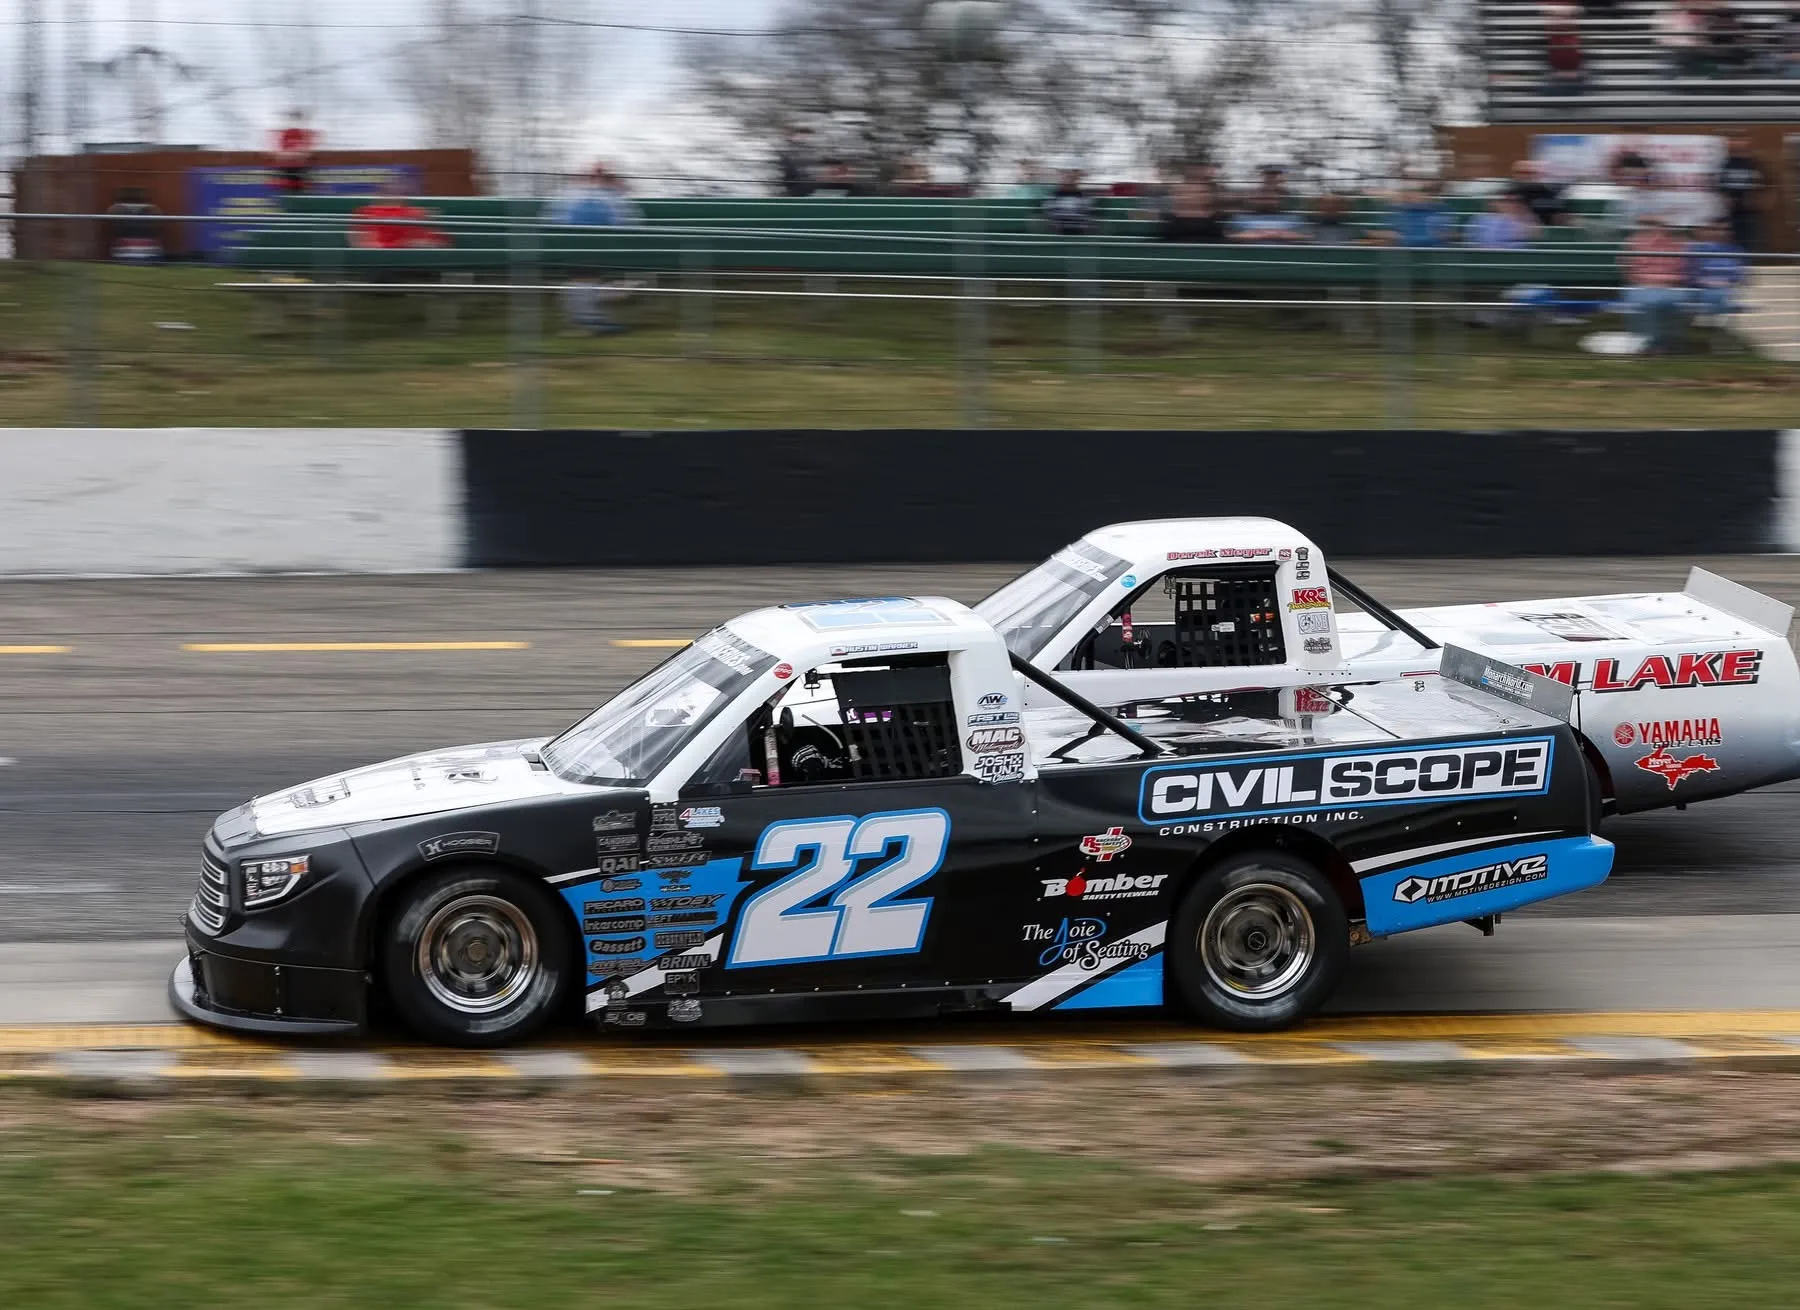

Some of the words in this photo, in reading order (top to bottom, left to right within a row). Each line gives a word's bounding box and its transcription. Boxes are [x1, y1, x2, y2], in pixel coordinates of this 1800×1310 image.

[1292, 587, 1327, 604] KRC
[1591, 650, 1762, 692] LAKE
[971, 728, 1021, 745] MAC
[1638, 717, 1721, 744] YAMAHA
[1652, 739, 1684, 750] GOLF
[1687, 736, 1722, 748] CARS
[974, 755, 1012, 770] JOSH
[983, 763, 1022, 778] LUNT
[1150, 766, 1317, 815] CIVIL
[1329, 747, 1542, 798] SCOPE
[1325, 810, 1364, 822] INC.
[601, 857, 638, 873] QA1
[725, 807, 951, 970] 22
[1082, 892, 1117, 901] SAFETY
[1117, 889, 1160, 899] EYEWEAR
[584, 919, 644, 932] Intercomp
[1021, 924, 1054, 942] The
[592, 938, 642, 953] Bassett
[660, 955, 711, 969] BRINN
[1062, 942, 1081, 964] of
[1080, 939, 1151, 970] Seating
